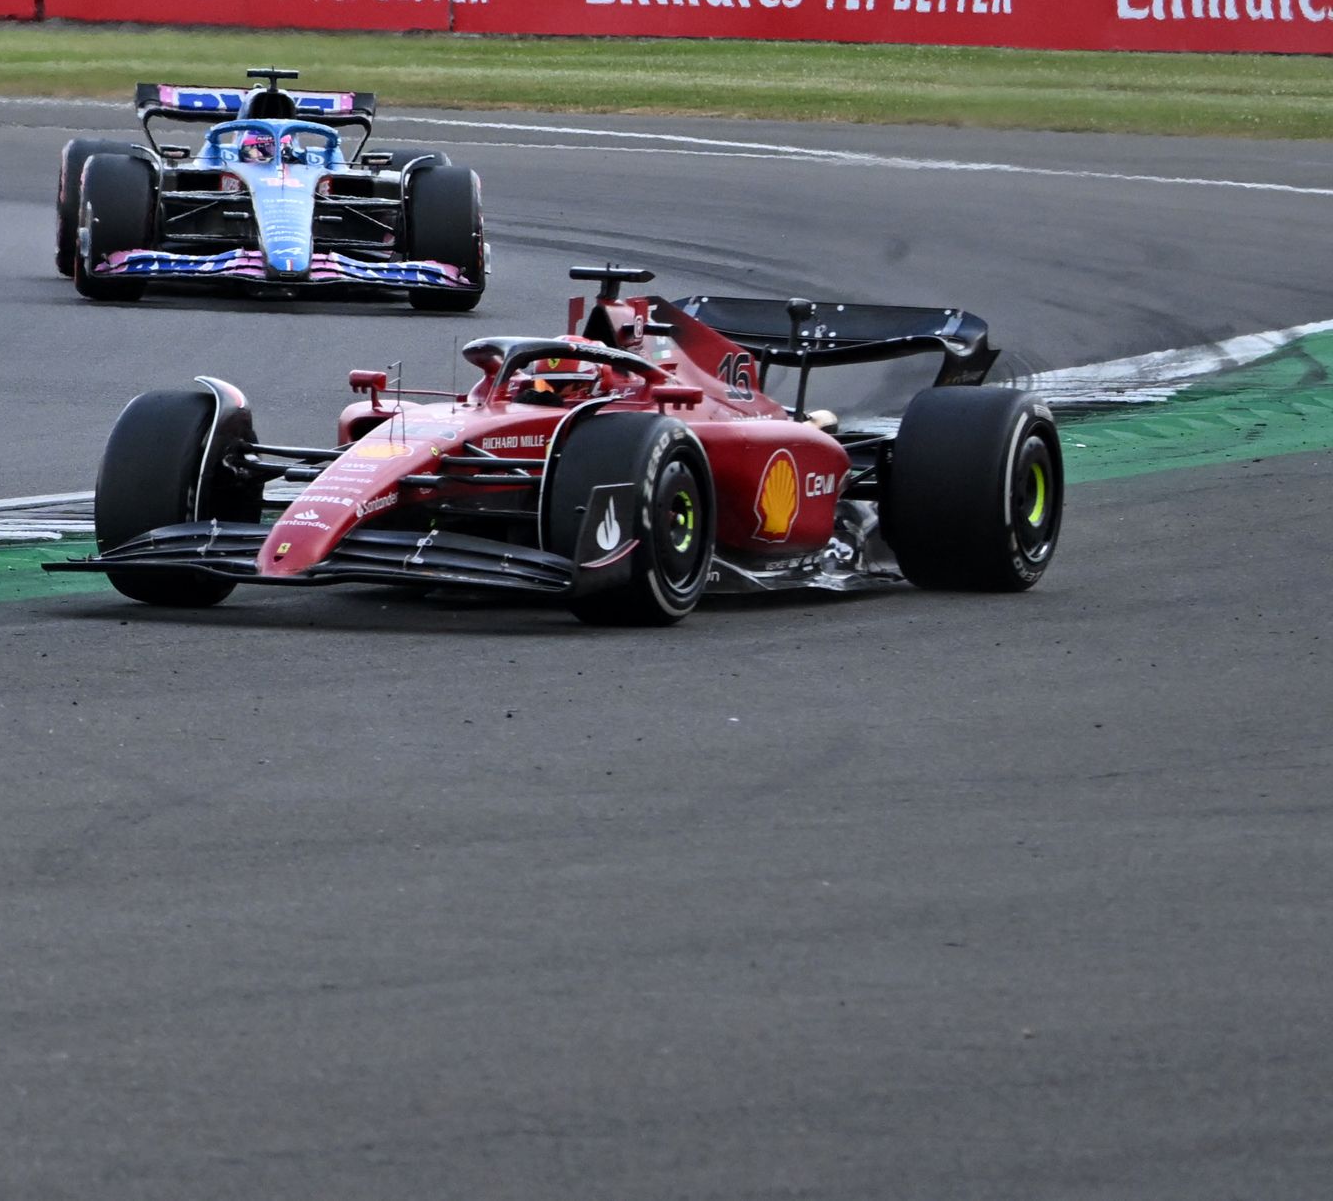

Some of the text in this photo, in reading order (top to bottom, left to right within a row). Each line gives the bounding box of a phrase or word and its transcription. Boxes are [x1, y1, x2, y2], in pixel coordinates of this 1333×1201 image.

[716, 351, 755, 403] 16
[482, 434, 545, 449] RICHARD MILLE
